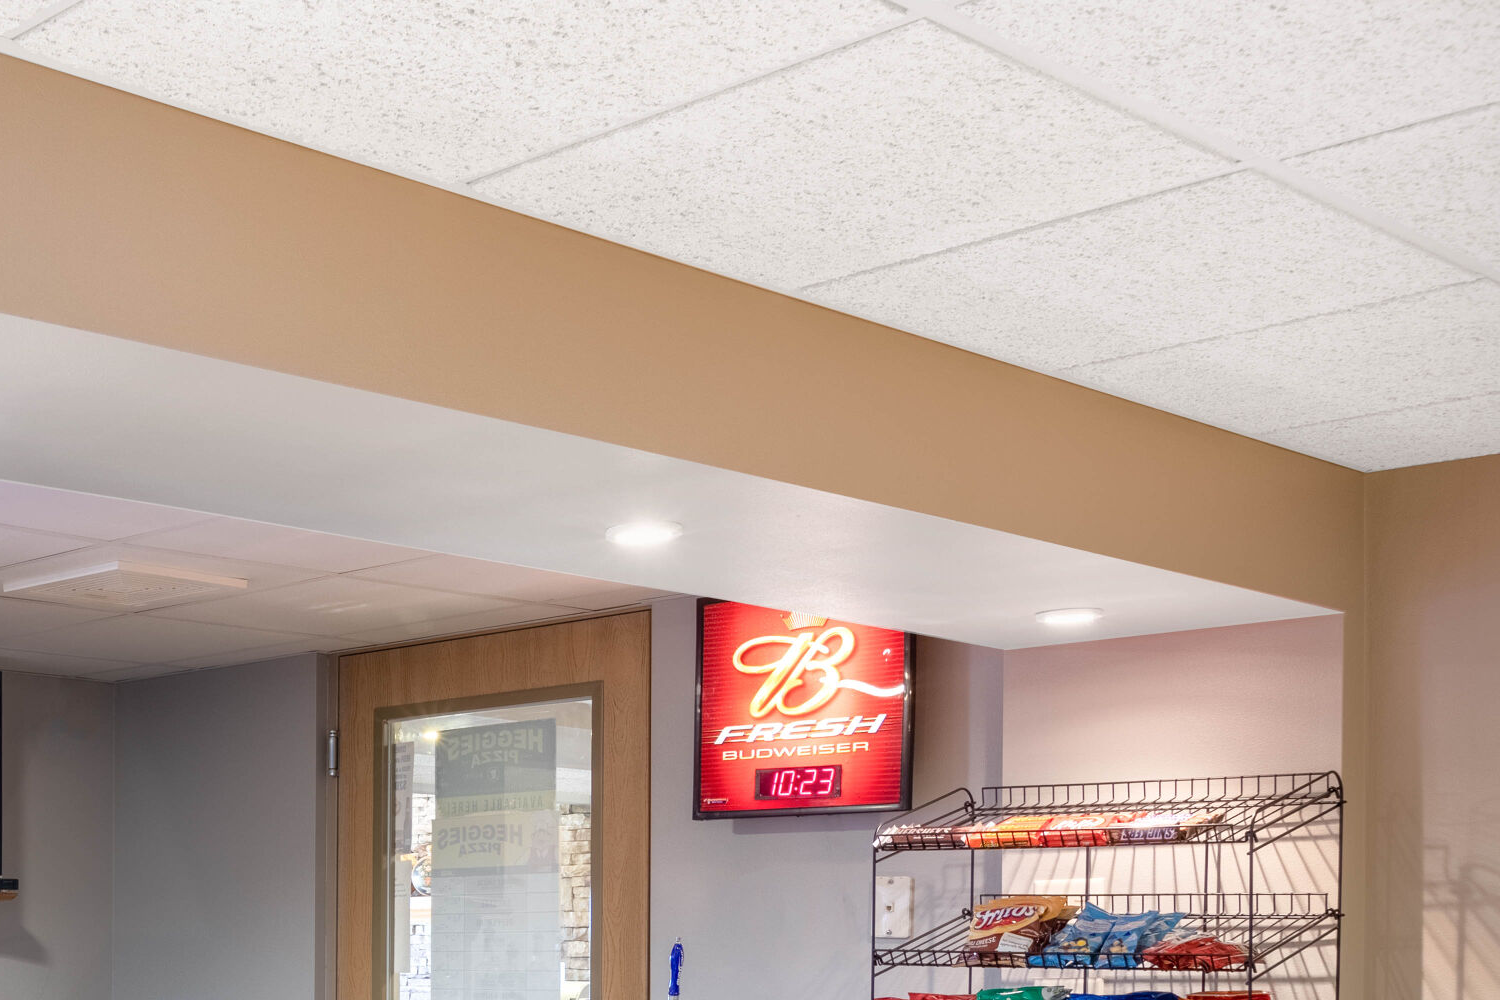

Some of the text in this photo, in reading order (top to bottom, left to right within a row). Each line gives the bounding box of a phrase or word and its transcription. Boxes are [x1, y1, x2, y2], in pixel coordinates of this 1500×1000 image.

[713, 713, 887, 745] FRESH
[722, 742, 869, 761] BUDWEISER
[771, 767, 835, 797] 10:23
